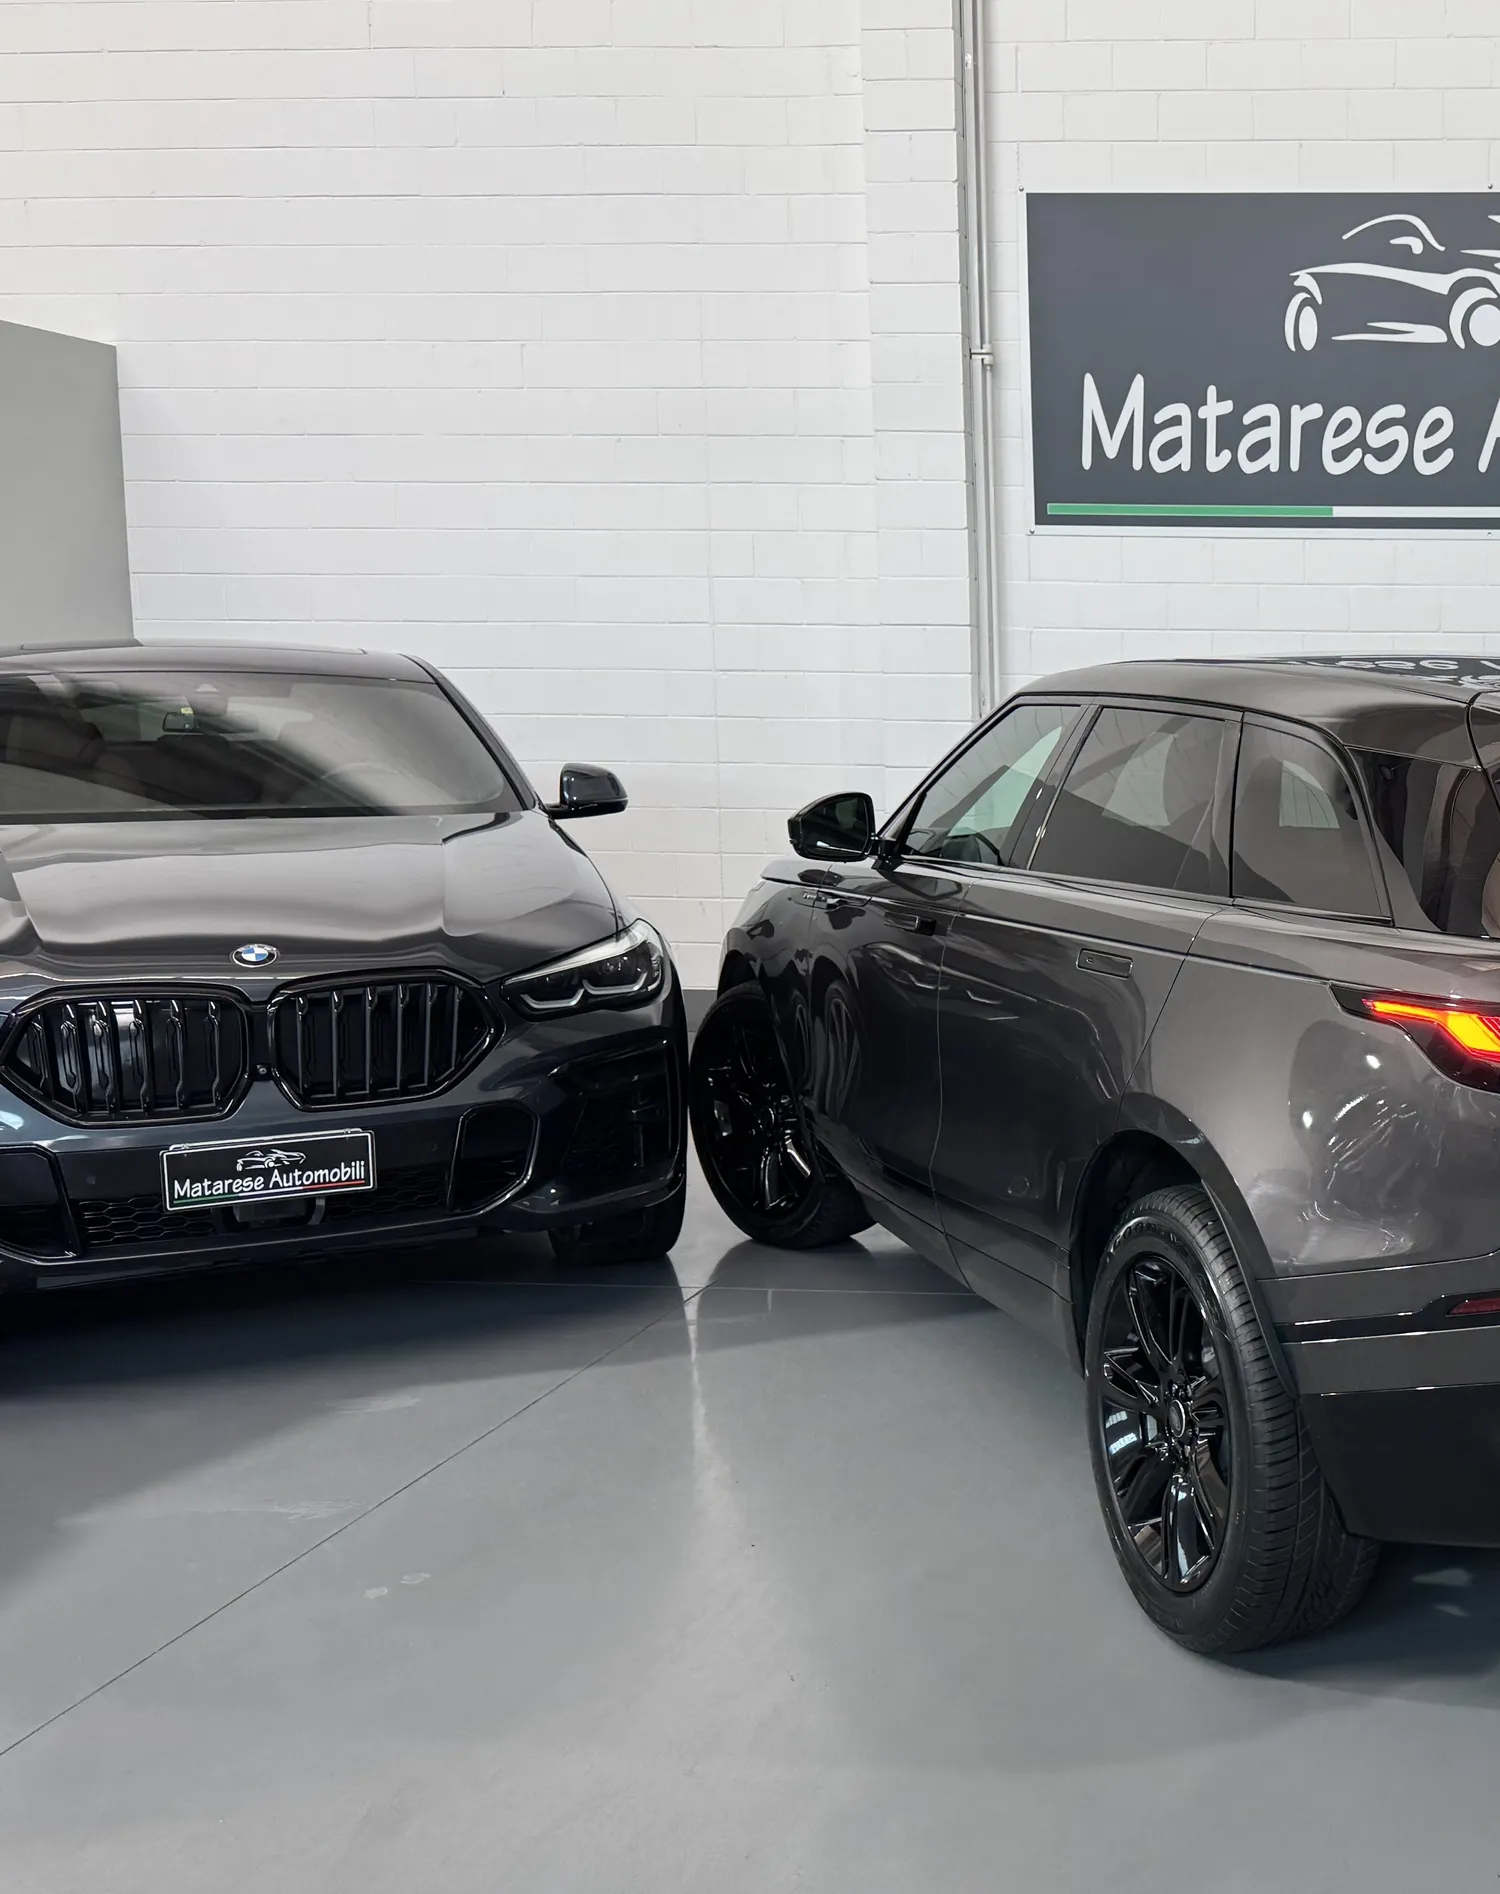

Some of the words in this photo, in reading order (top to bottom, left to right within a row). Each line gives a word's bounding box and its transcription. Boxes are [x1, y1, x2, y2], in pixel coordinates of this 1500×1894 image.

[1081, 372, 1454, 476] Matarese
[173, 1175, 265, 1200] Matarese
[269, 1160, 366, 1189] Automobili
